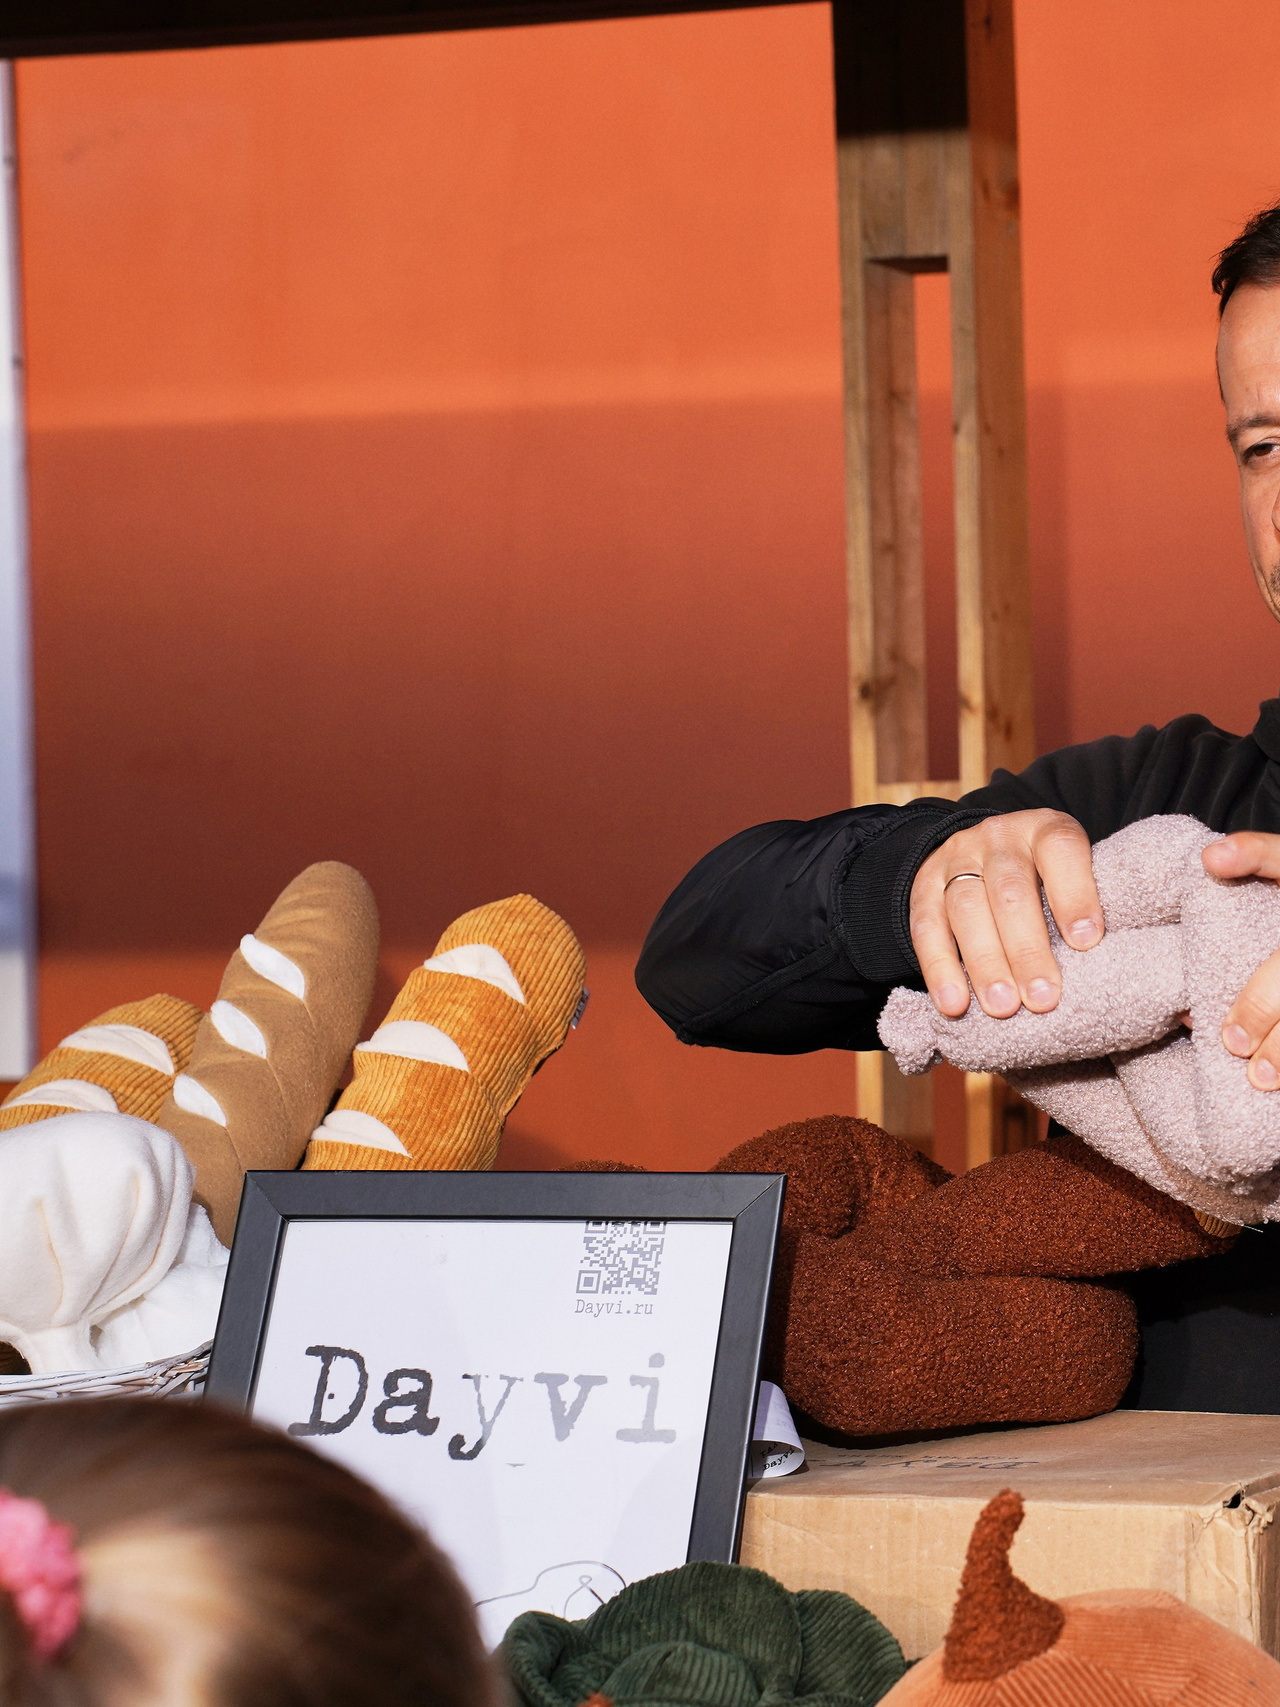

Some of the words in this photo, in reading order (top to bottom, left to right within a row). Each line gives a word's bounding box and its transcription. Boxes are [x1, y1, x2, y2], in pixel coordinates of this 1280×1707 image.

[574, 1298, 654, 1318] Dayvi.ru
[287, 1344, 677, 1461] Dayvi
[762, 1446, 795, 1471] Dayvi
[806, 1458, 1039, 1470] Dayv
